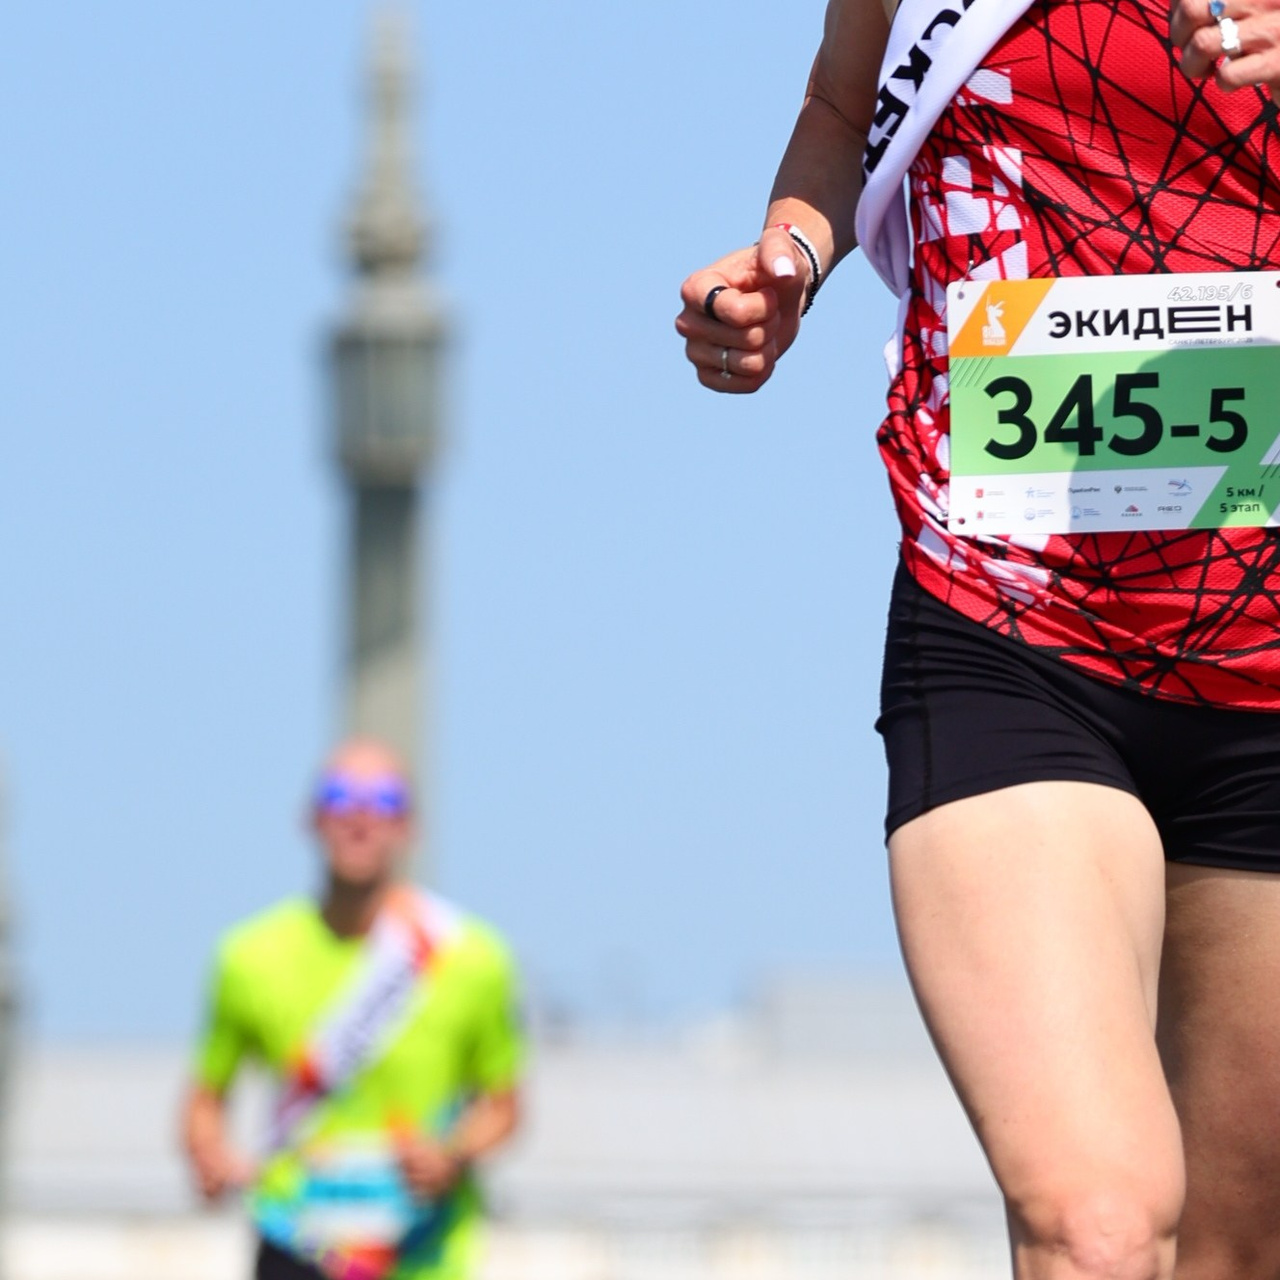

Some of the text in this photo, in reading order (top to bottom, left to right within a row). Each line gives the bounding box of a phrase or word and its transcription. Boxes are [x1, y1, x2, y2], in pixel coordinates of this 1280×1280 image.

[1167, 282, 1253, 301] 42.195/6
[1048, 304, 1253, 340] ЭКИДЕН
[983, 372, 1249, 460] 345-5
[1226, 487, 1234, 497] 5
[1237, 488, 1255, 496] км
[1220, 503, 1260, 513] 5 этап
